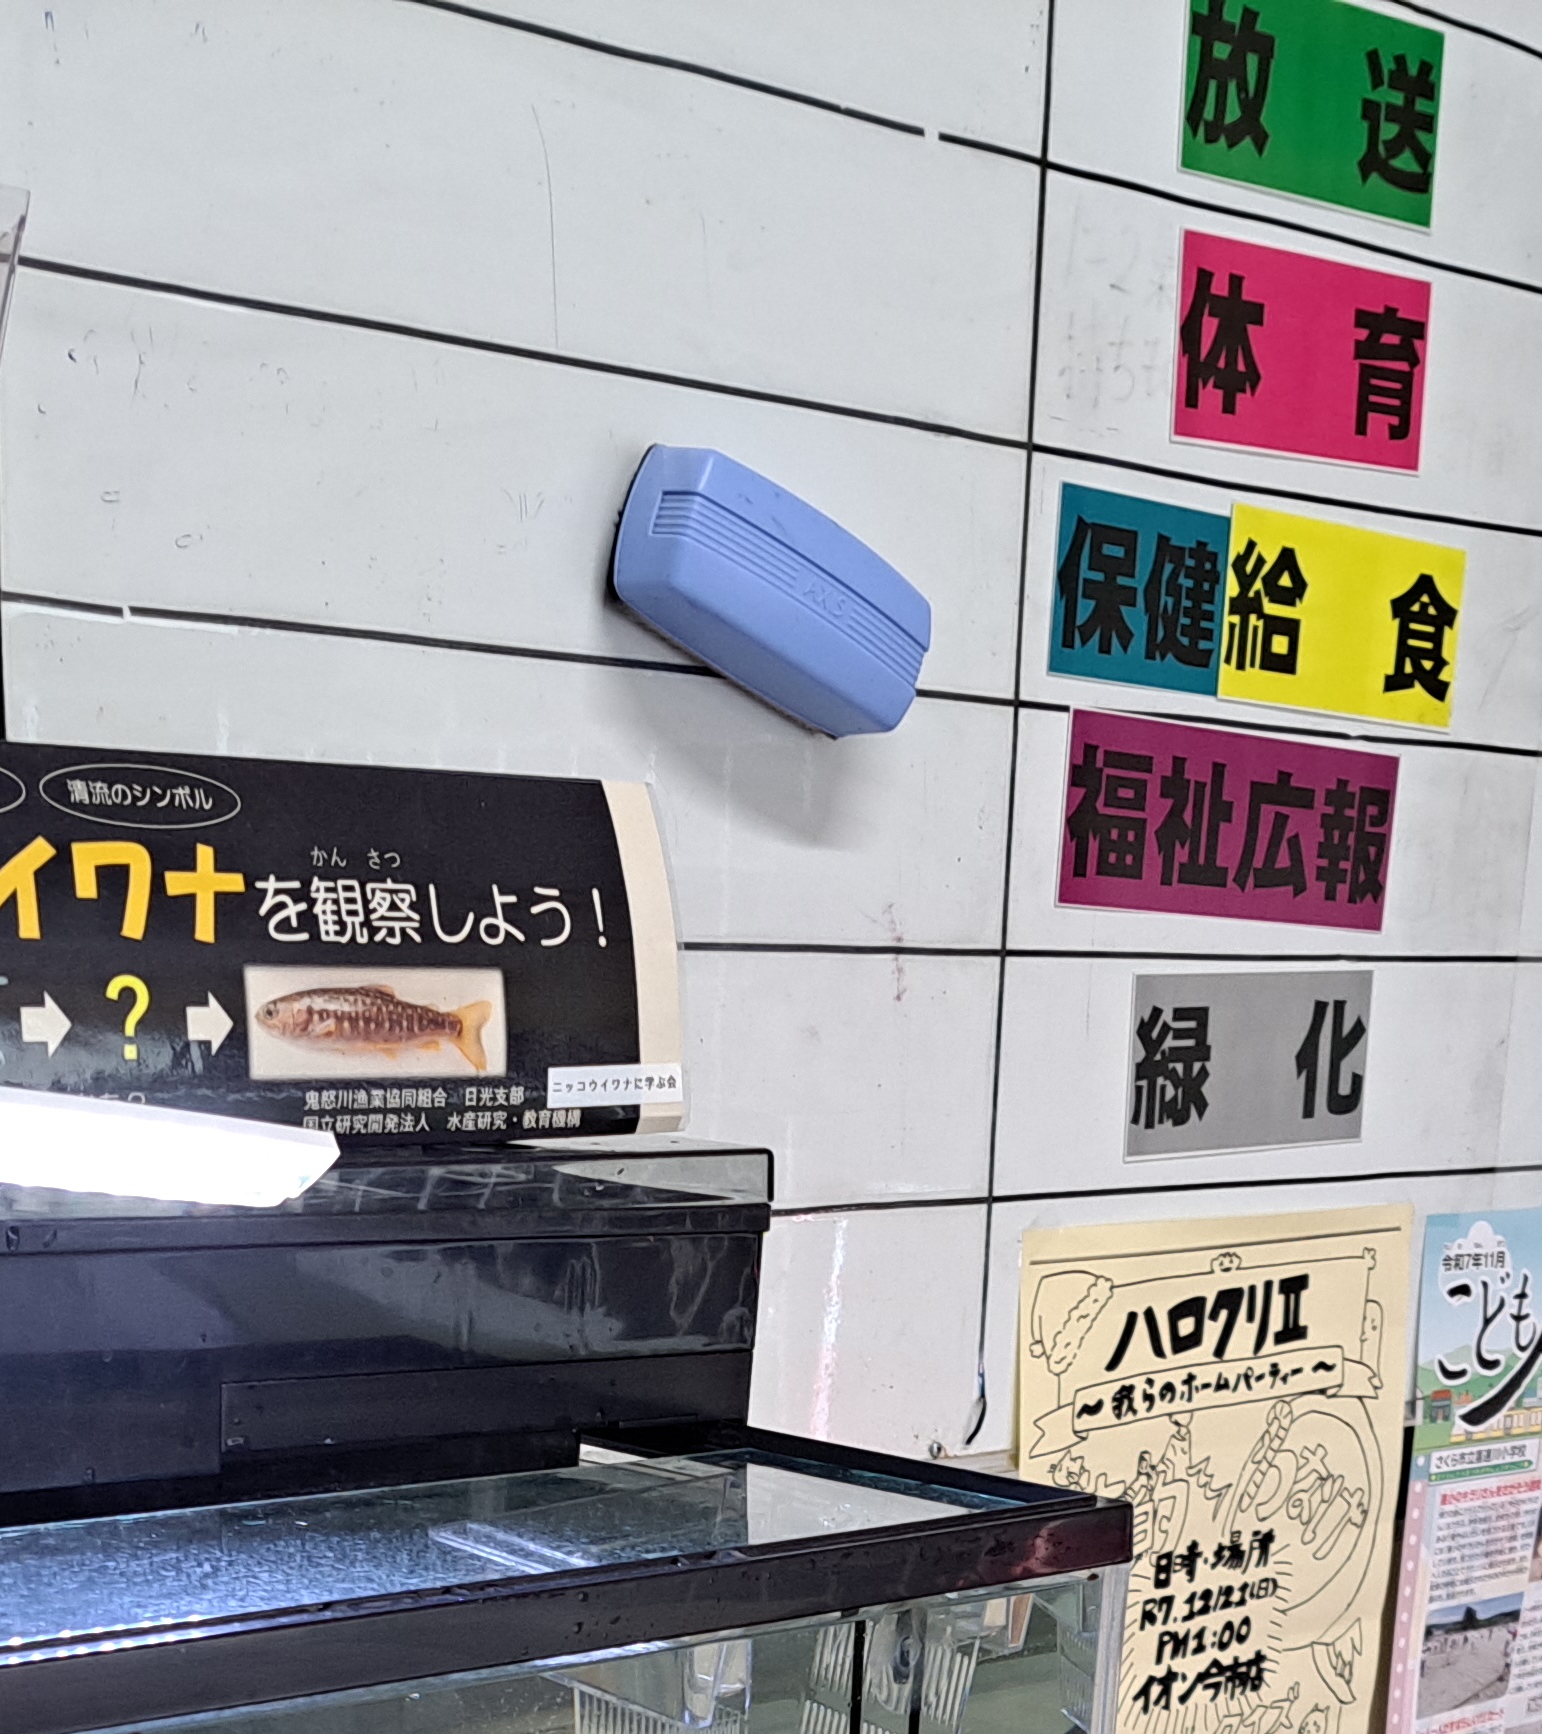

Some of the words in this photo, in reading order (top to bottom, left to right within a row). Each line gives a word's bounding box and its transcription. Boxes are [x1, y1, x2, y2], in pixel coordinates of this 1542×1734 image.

[1181, 267, 1425, 441] 体育
[1058, 515, 1220, 670] 保健
[1223, 537, 1458, 704] 給食
[67, 778, 214, 811] 清流のシンボル
[1066, 743, 1392, 905] 福祉広報
[310, 845, 347, 867] かん
[366, 846, 401, 867] さつ
[304, 1087, 448, 1111] 鬼怒川漁業協同組合
[464, 1085, 525, 1107] 日光支部
[550, 1073, 678, 1095] ニッコウイワナに学ぶ会
[1130, 1000, 1367, 1131] 緑化
[303, 1110, 431, 1134] 国立研究開発法人
[446, 1108, 581, 1132] 水産研究・教育機構
